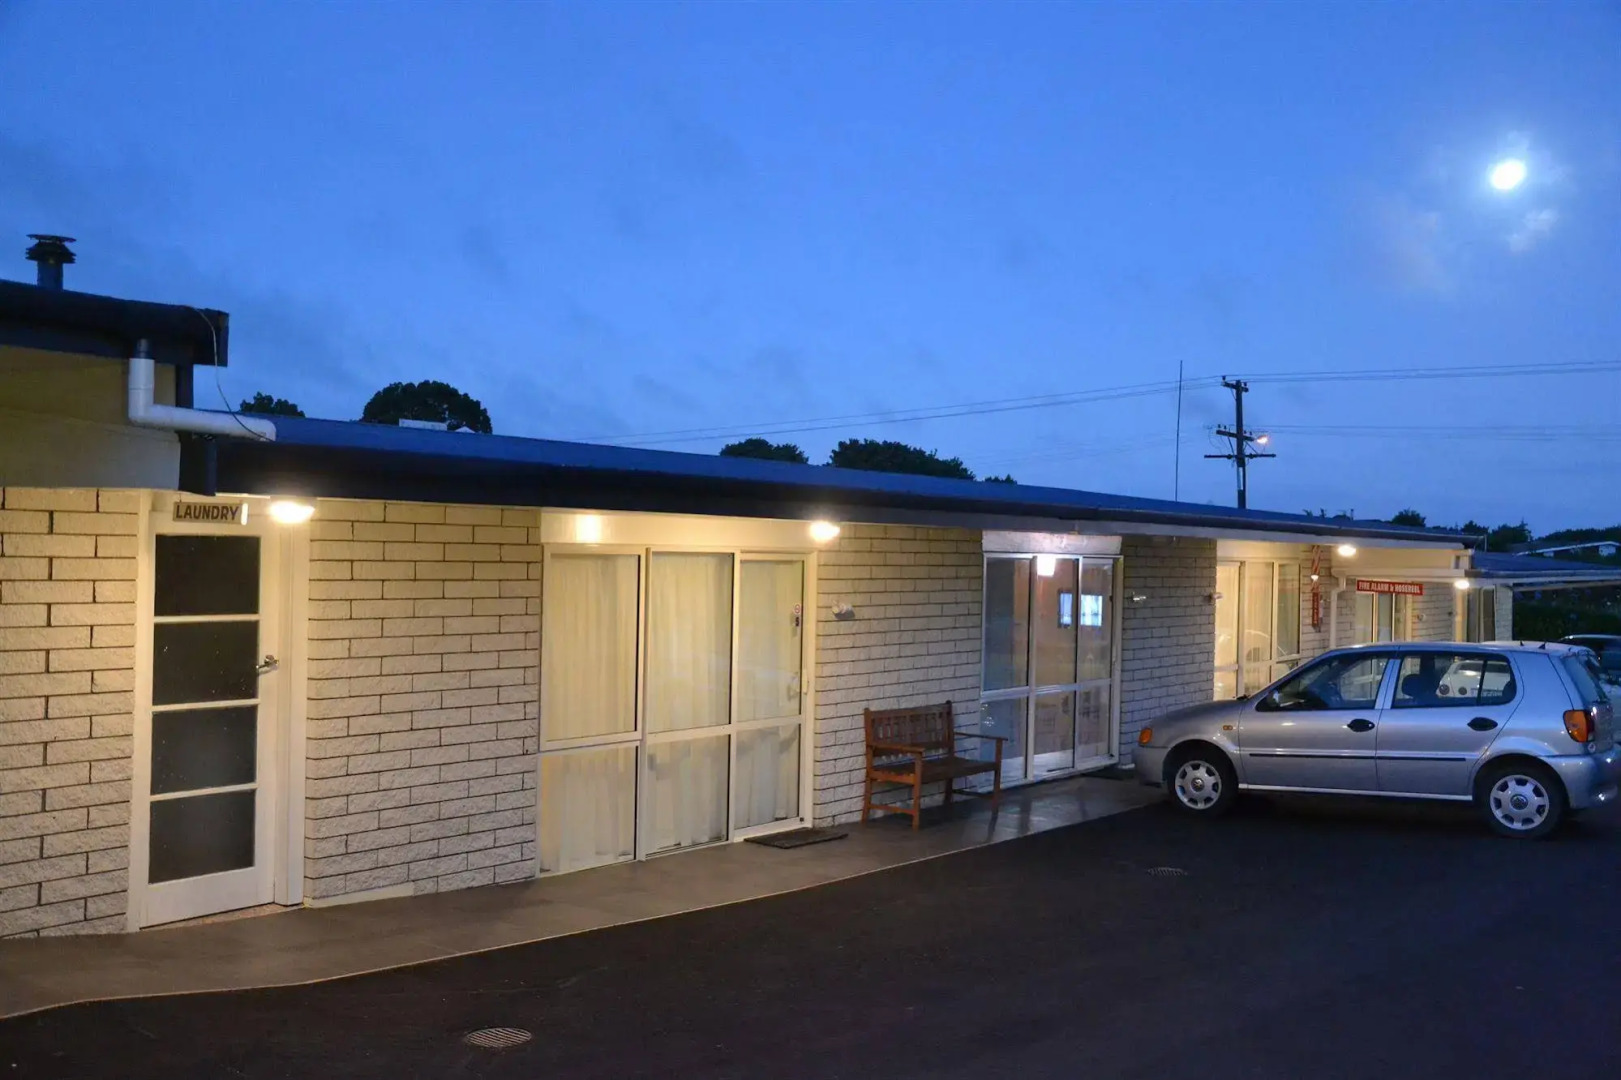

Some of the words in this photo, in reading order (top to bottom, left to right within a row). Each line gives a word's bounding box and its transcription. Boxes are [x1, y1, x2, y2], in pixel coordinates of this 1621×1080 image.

[175, 504, 240, 520] LAUNDRY
[1358, 581, 1370, 590] FIRE
[1371, 582, 1389, 592] ALARM
